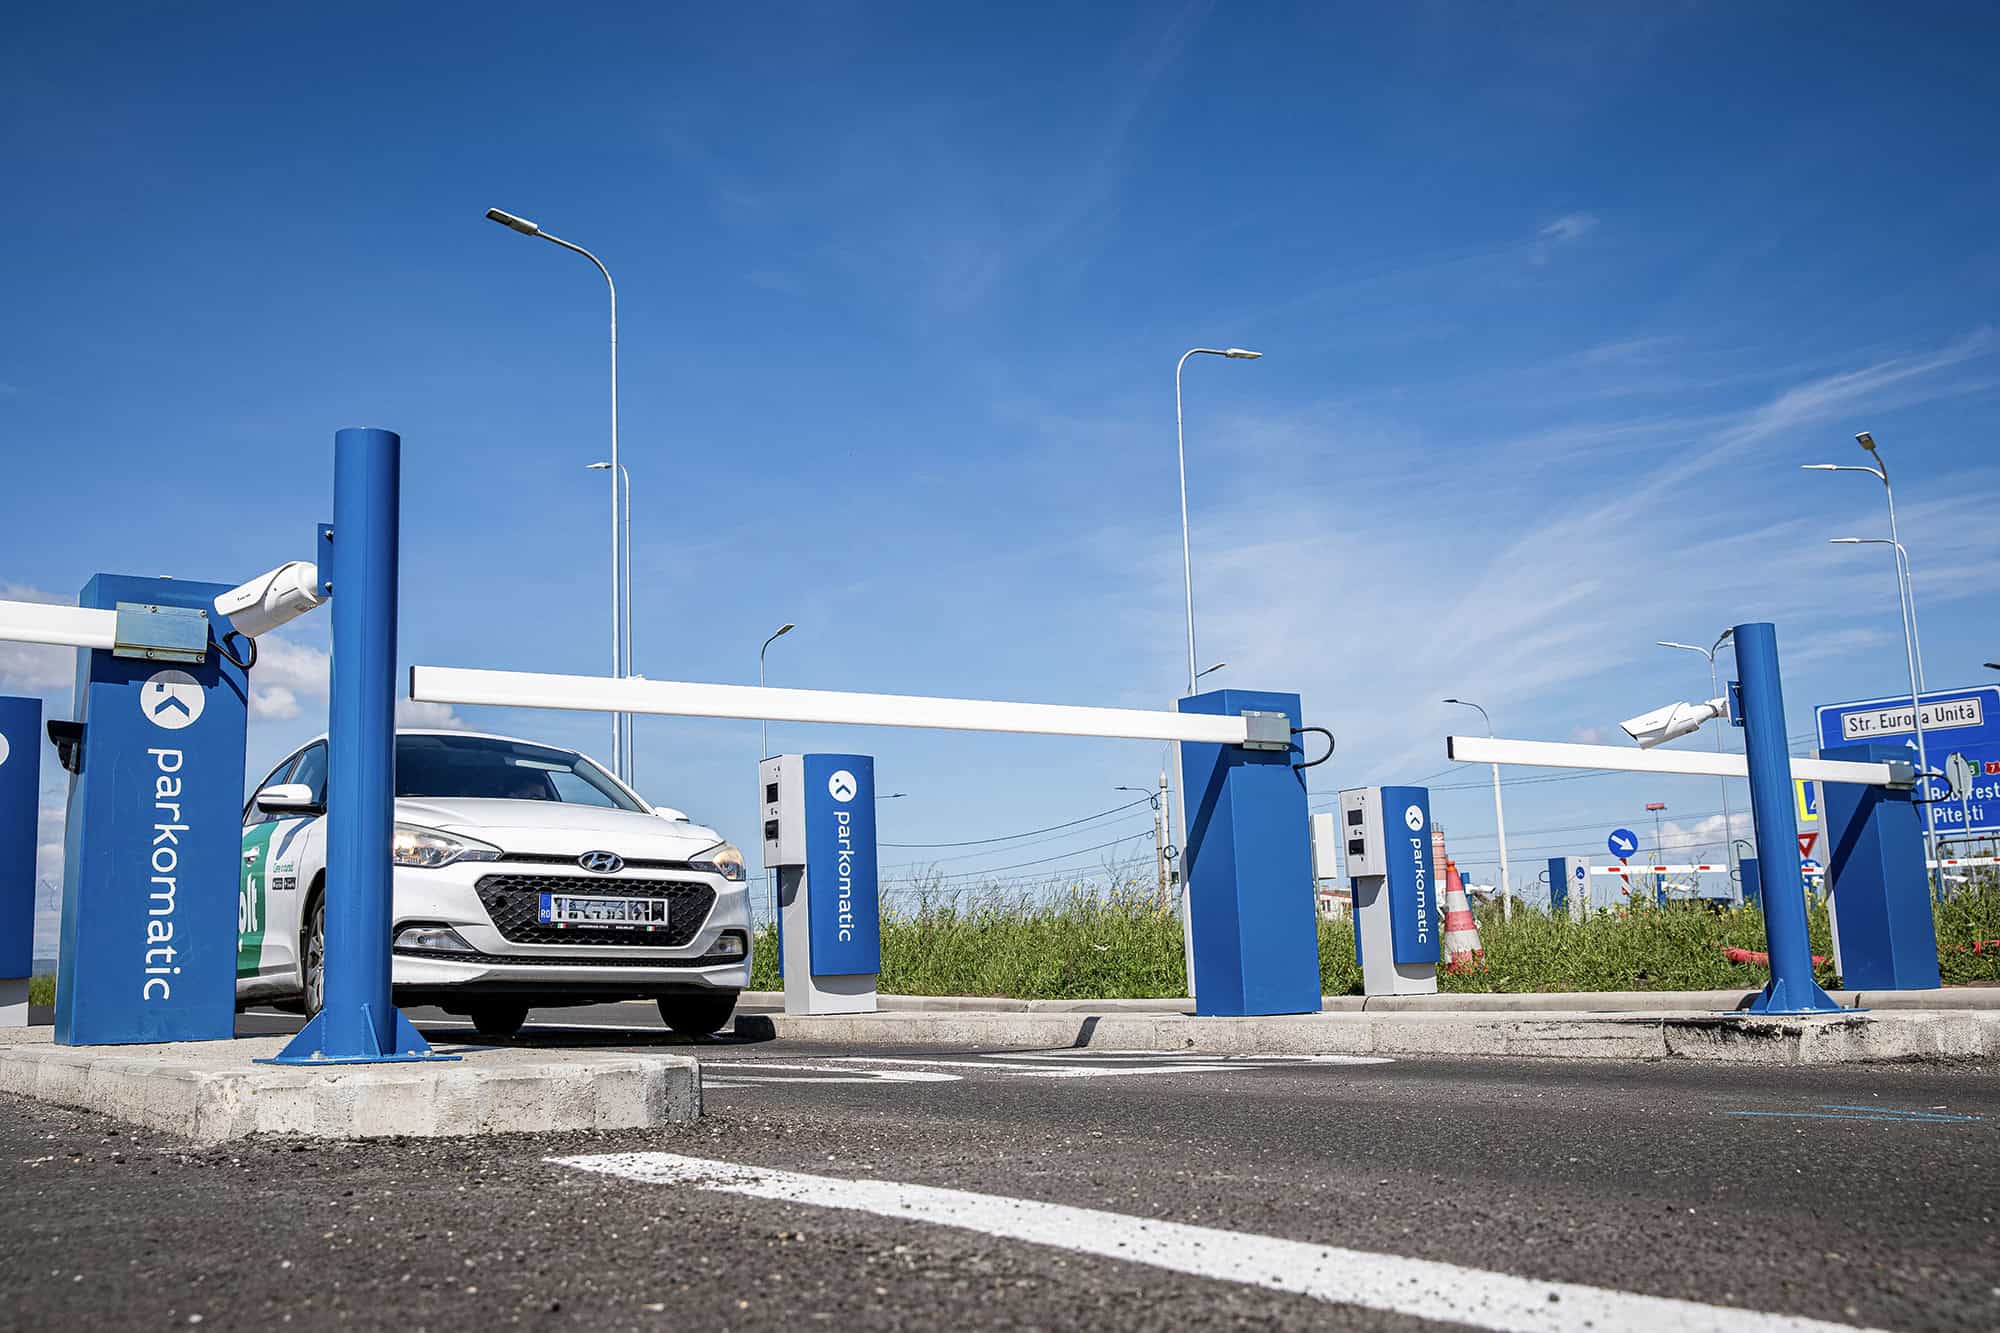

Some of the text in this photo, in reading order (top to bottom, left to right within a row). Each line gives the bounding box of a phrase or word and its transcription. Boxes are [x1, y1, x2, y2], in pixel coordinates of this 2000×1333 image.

[1849, 717, 1876, 732] Str.
[143, 748, 190, 1001] parkomatic
[239, 872, 258, 935] olt
[833, 811, 855, 942] parkomatic
[1409, 838, 1429, 944] parkomatic
